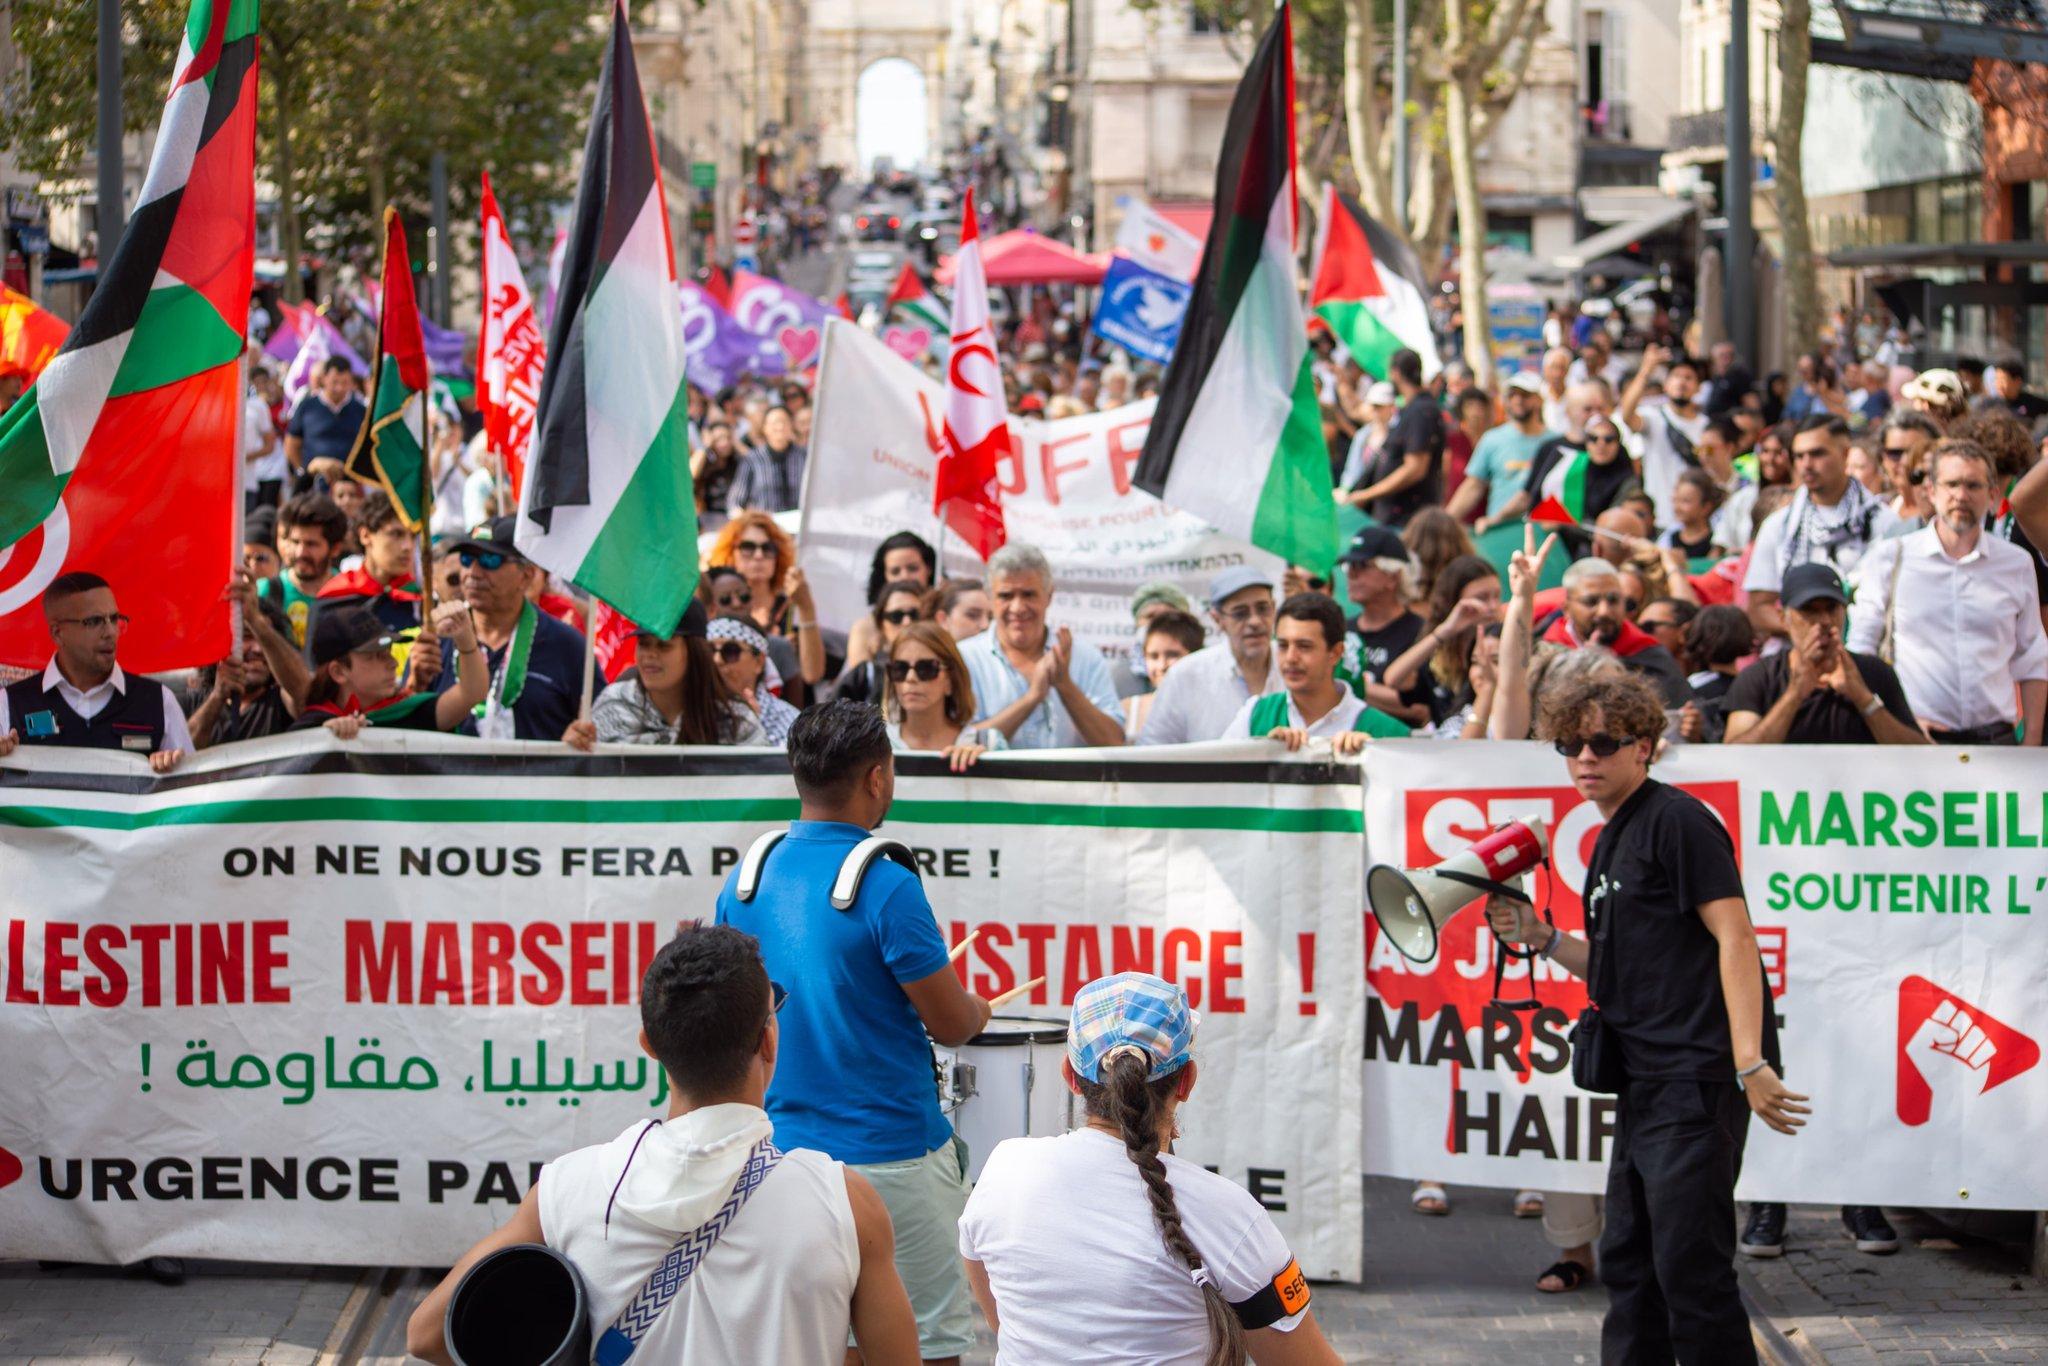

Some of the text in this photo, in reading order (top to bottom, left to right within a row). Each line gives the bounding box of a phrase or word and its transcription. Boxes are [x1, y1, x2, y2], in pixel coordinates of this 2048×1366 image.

[1759, 790, 2048, 848] MARSEIL
[223, 847, 294, 877] ON
[315, 845, 379, 875] NE
[400, 846, 542, 877] NOUS
[561, 847, 693, 876] FERA
[1766, 872, 1991, 915] SOUTENIR
[3, 918, 291, 1007] LESTINE
[176, 1036, 439, 1105] مقاومة
[1454, 1089, 1619, 1162] HAIF
[39, 1155, 400, 1202] URGENCE
